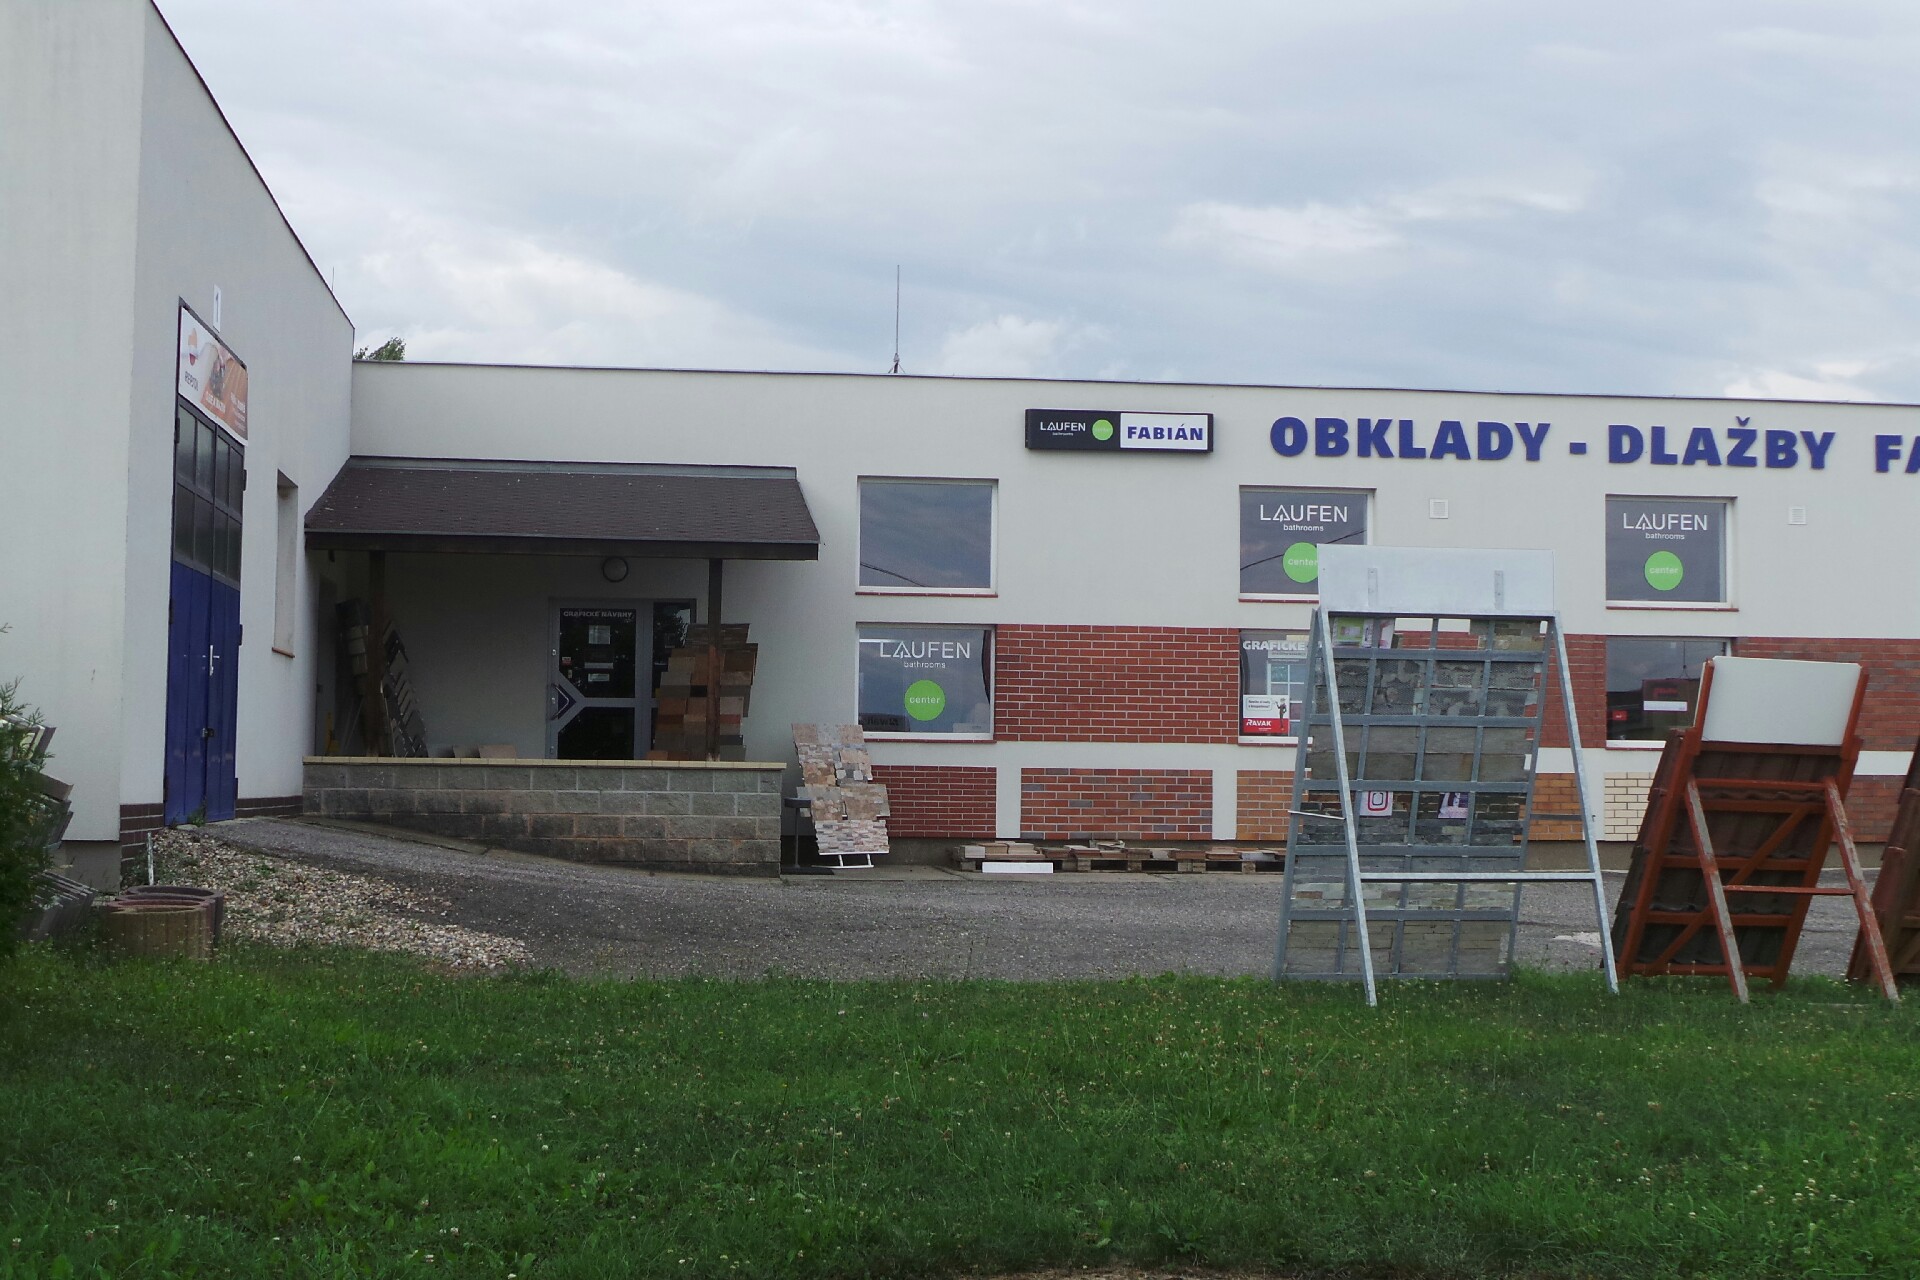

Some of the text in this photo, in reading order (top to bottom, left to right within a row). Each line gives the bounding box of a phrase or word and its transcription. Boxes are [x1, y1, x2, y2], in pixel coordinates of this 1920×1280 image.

[1040, 421, 1086, 432] LAUFEN
[1127, 423, 1203, 441] FABIÁN
[1270, 416, 1551, 461] OBKLADY
[1608, 416, 1836, 469] DLAŽBY
[1260, 504, 1348, 523] LAUFEN
[1623, 512, 1708, 531] LAUFEN
[1283, 524, 1324, 532] bathrooms
[1645, 532, 1685, 540] bathrooms
[879, 641, 970, 659] LAUFEN
[903, 661, 946, 669] bathrooms
[909, 696, 941, 704] center
[1246, 719, 1272, 727] RAVAK
